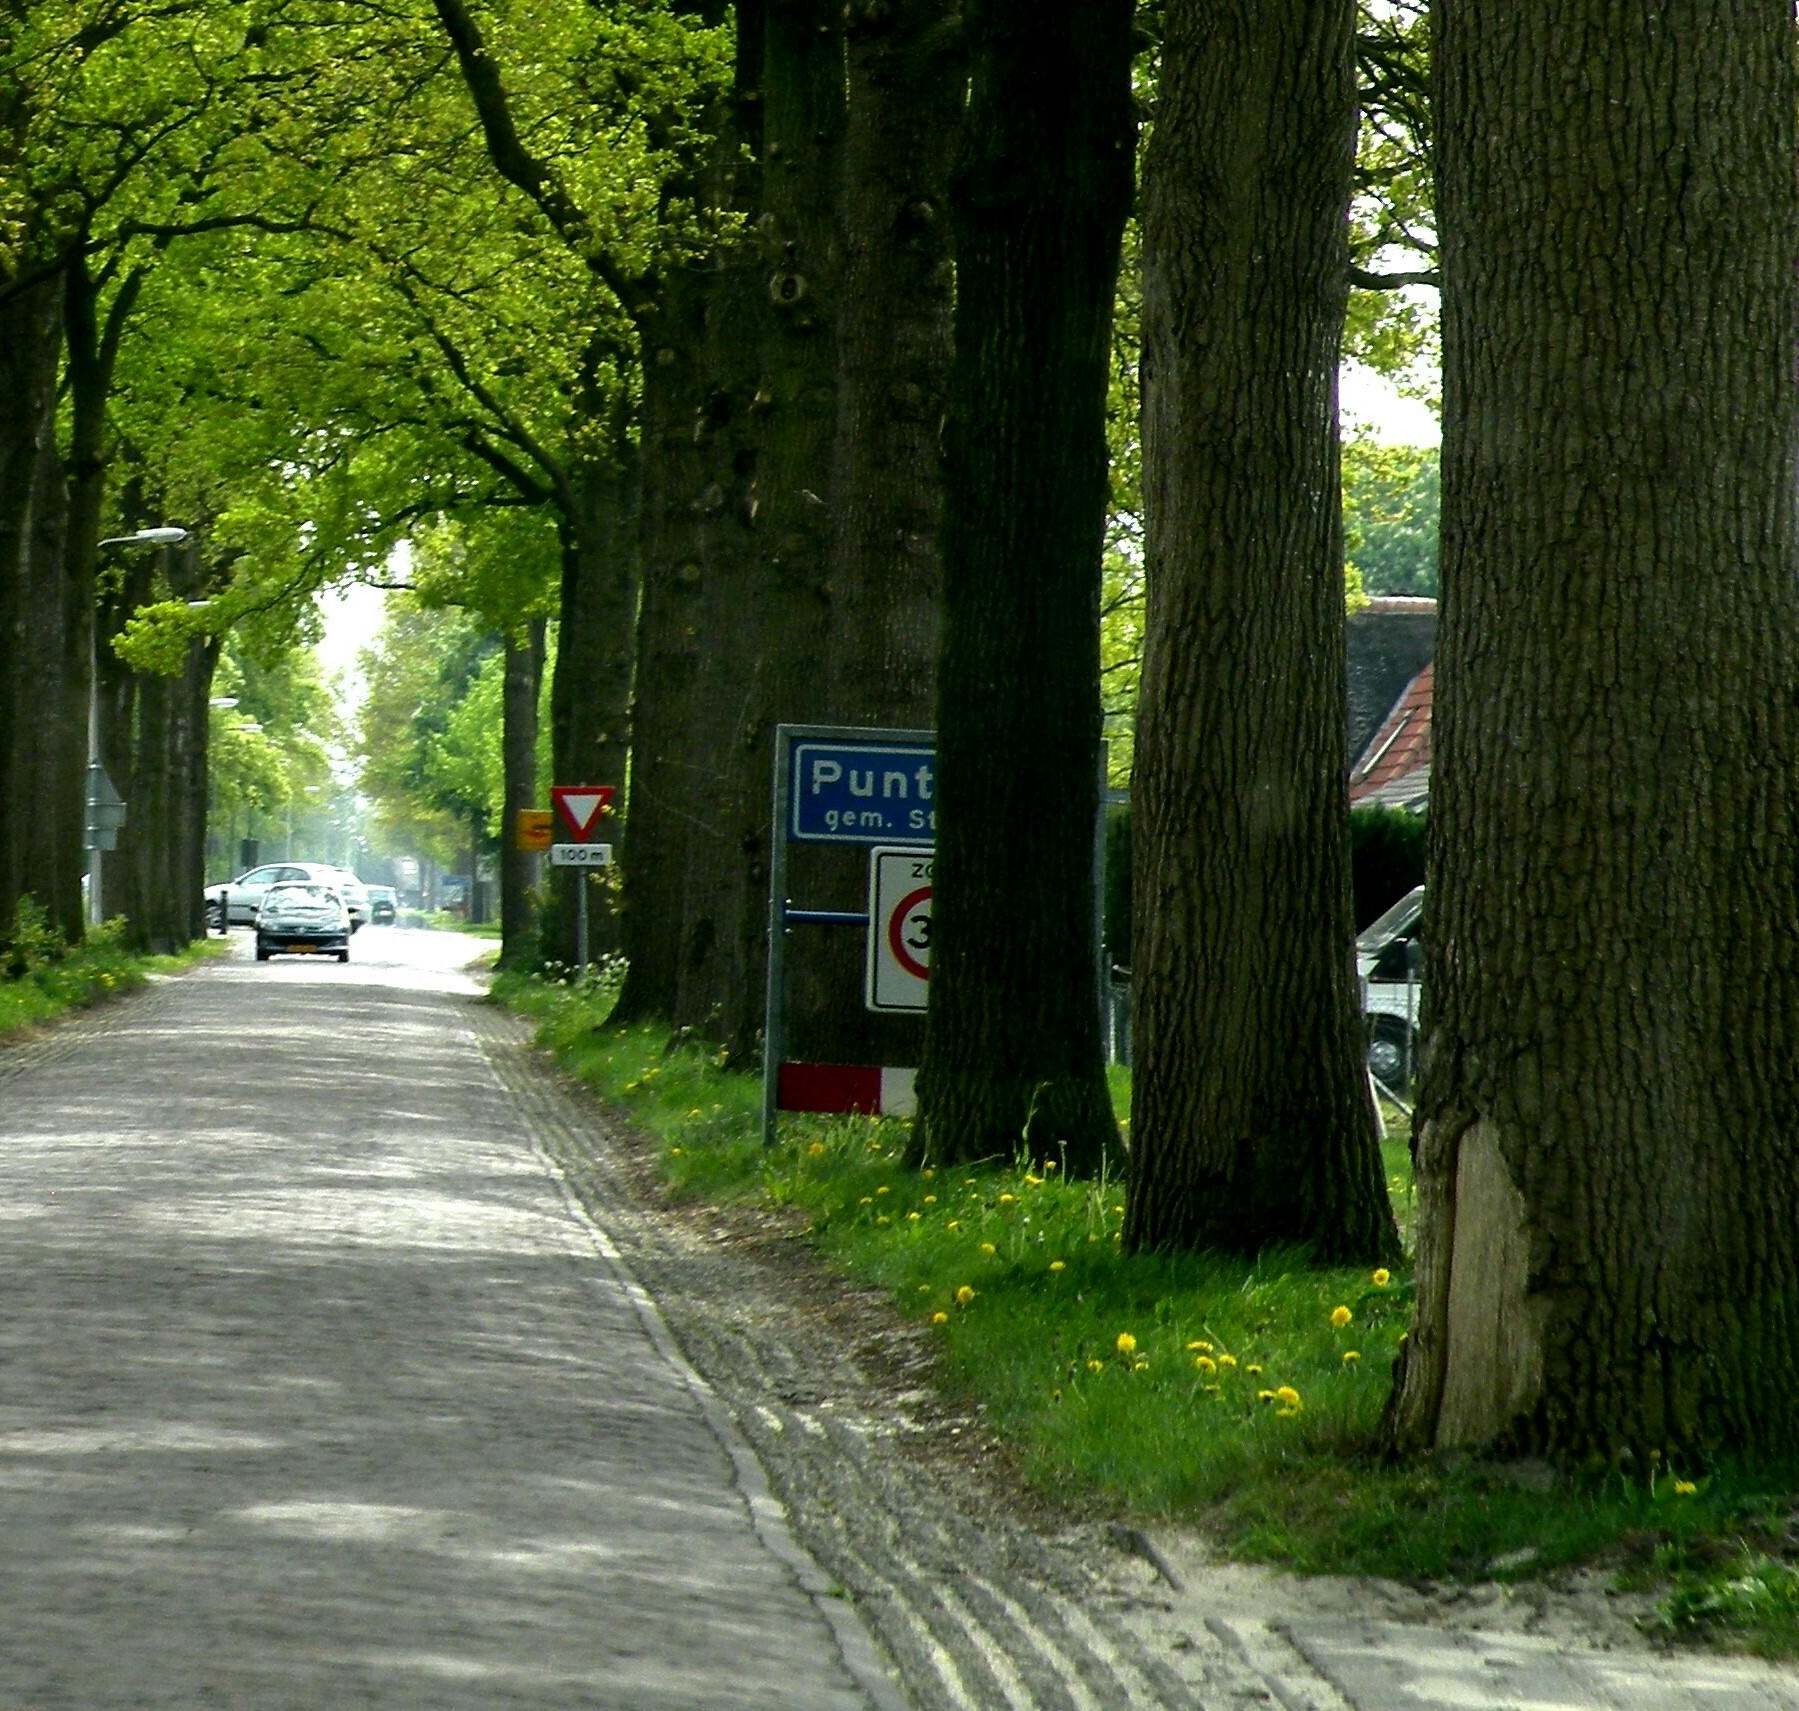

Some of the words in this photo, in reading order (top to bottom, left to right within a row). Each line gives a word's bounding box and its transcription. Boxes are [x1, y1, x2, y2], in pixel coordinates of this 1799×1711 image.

[824, 809, 893, 831] gem.
[561, 849, 587, 860] 100
[590, 851, 604, 861] m
